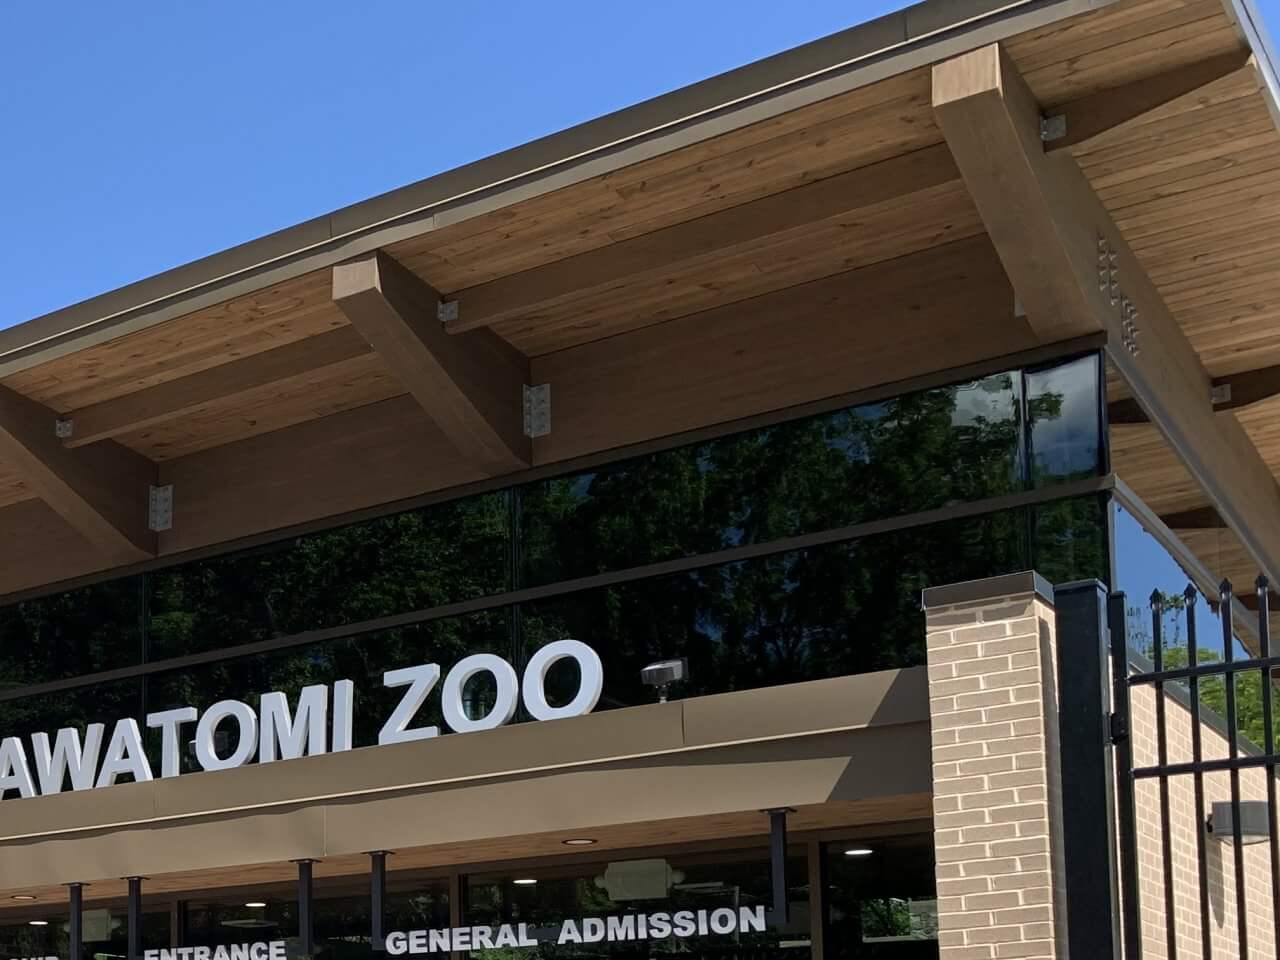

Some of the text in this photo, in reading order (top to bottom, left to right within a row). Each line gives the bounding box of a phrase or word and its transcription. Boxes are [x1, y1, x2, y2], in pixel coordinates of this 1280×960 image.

[378, 639, 603, 746] ZOO
[385, 905, 766, 955] GENERAL ADMISSION
